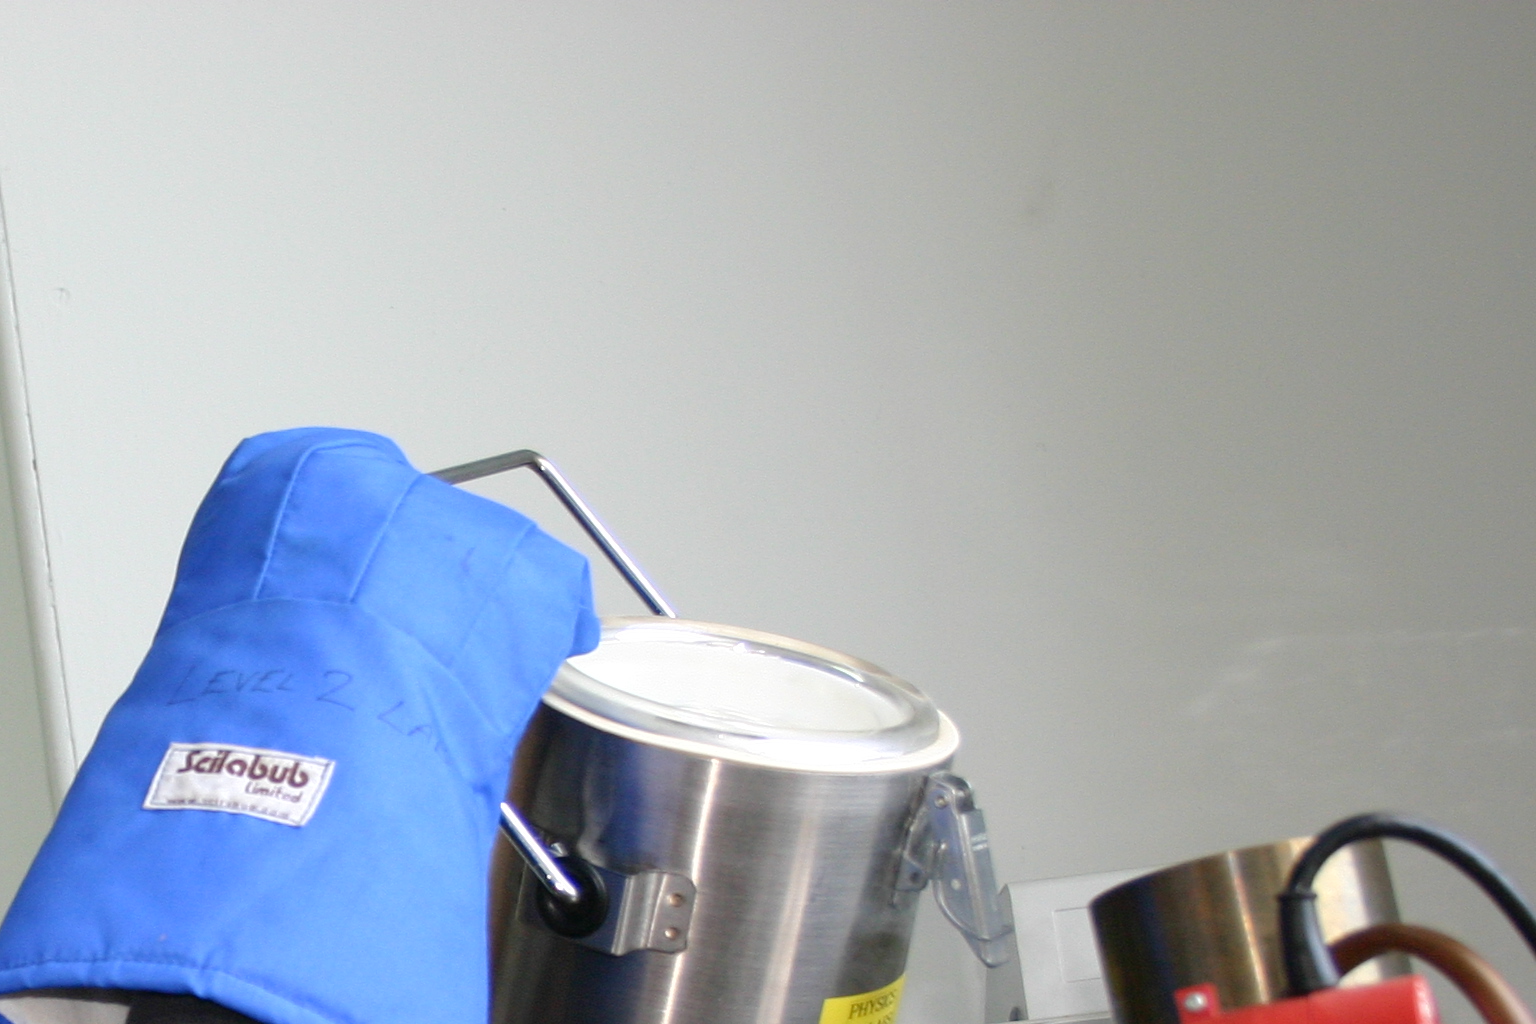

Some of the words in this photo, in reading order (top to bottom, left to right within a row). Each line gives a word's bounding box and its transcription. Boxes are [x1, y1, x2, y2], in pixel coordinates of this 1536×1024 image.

[166, 665, 294, 708] LEVEL
[317, 670, 355, 712] 2
[244, 780, 304, 804] Limited
[847, 989, 898, 1020] PHYSICS
